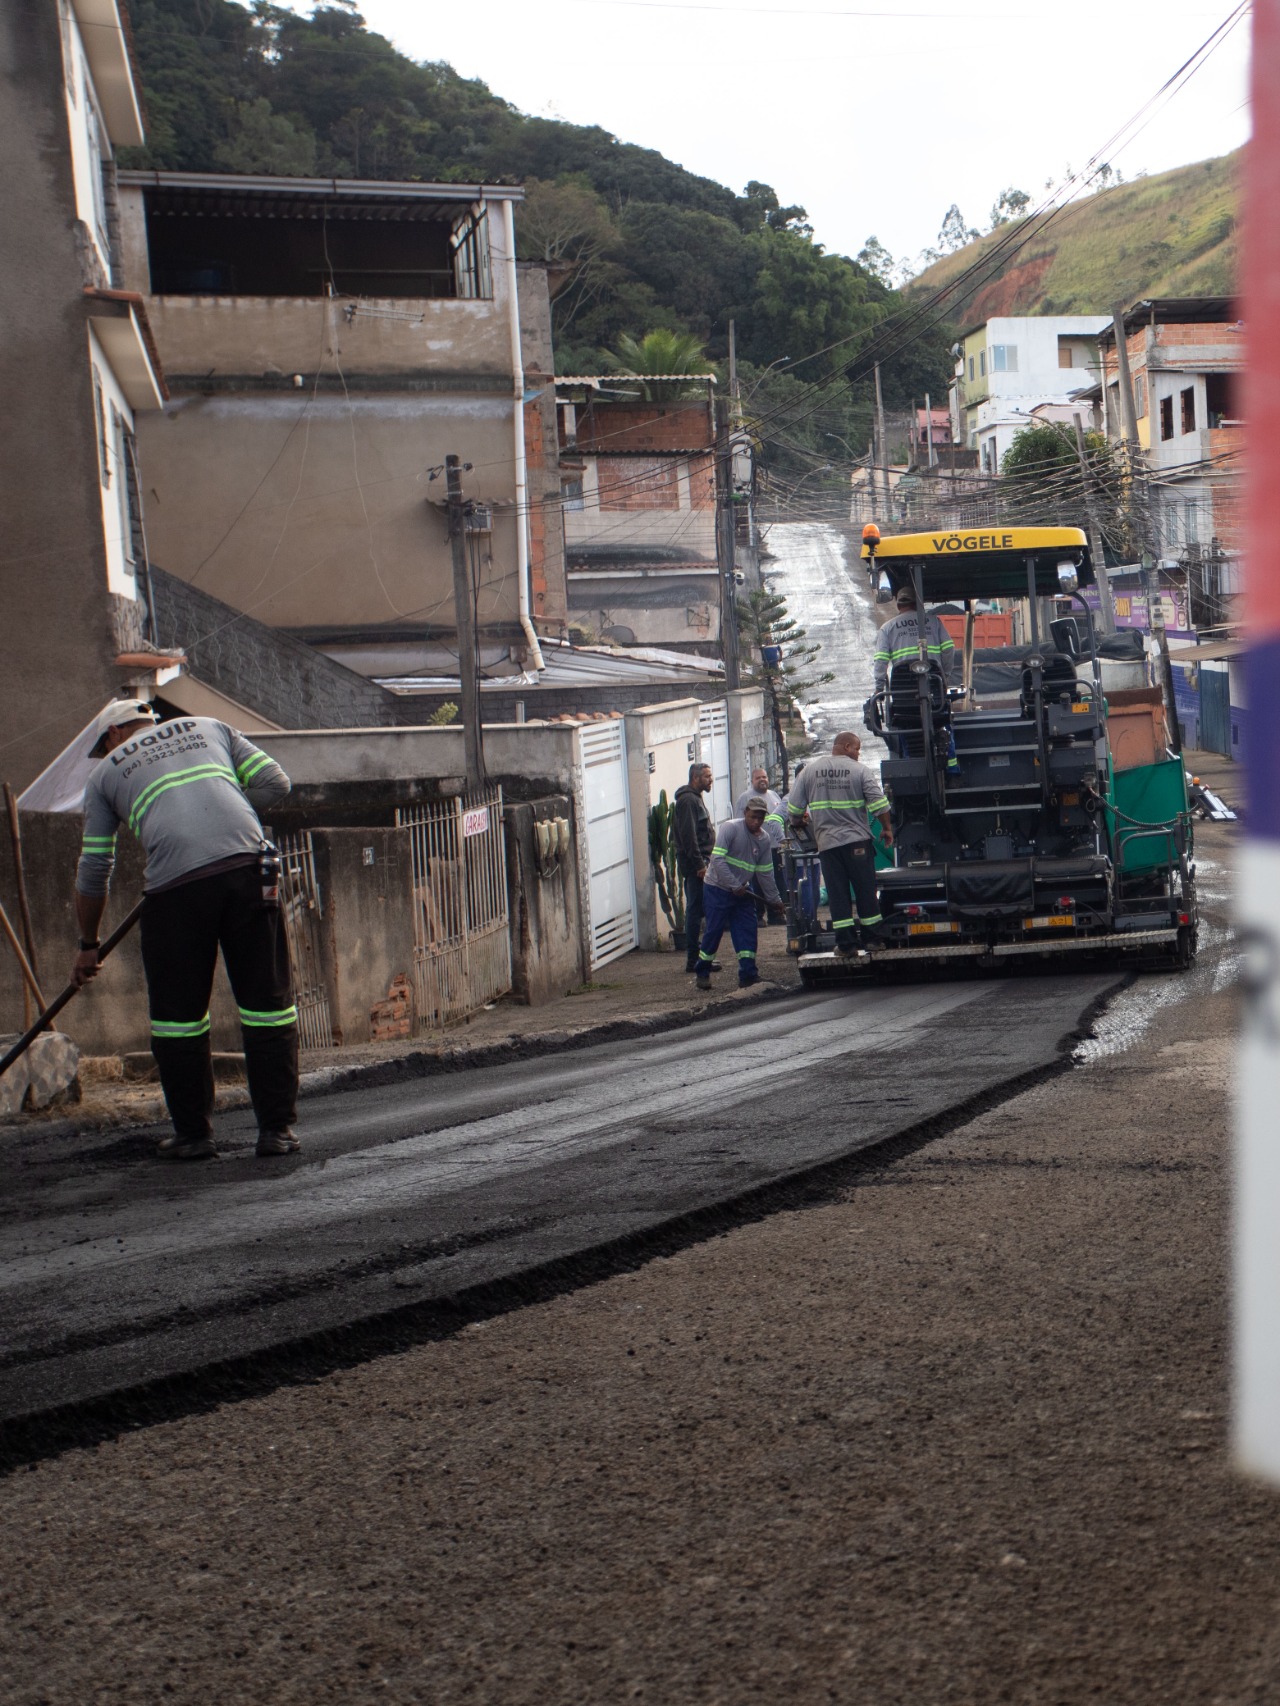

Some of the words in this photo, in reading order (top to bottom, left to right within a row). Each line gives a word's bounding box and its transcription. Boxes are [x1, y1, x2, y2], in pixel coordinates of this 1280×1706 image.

[932, 534, 1013, 551] VÖGELE
[895, 618, 930, 629] LUQUP
[110, 721, 197, 766] LUQUIP
[141, 733, 204, 757] 3323-3156
[122, 759, 142, 779] (24)
[145, 741, 208, 765] 3323-5495
[815, 769, 851, 778] LUQUIP
